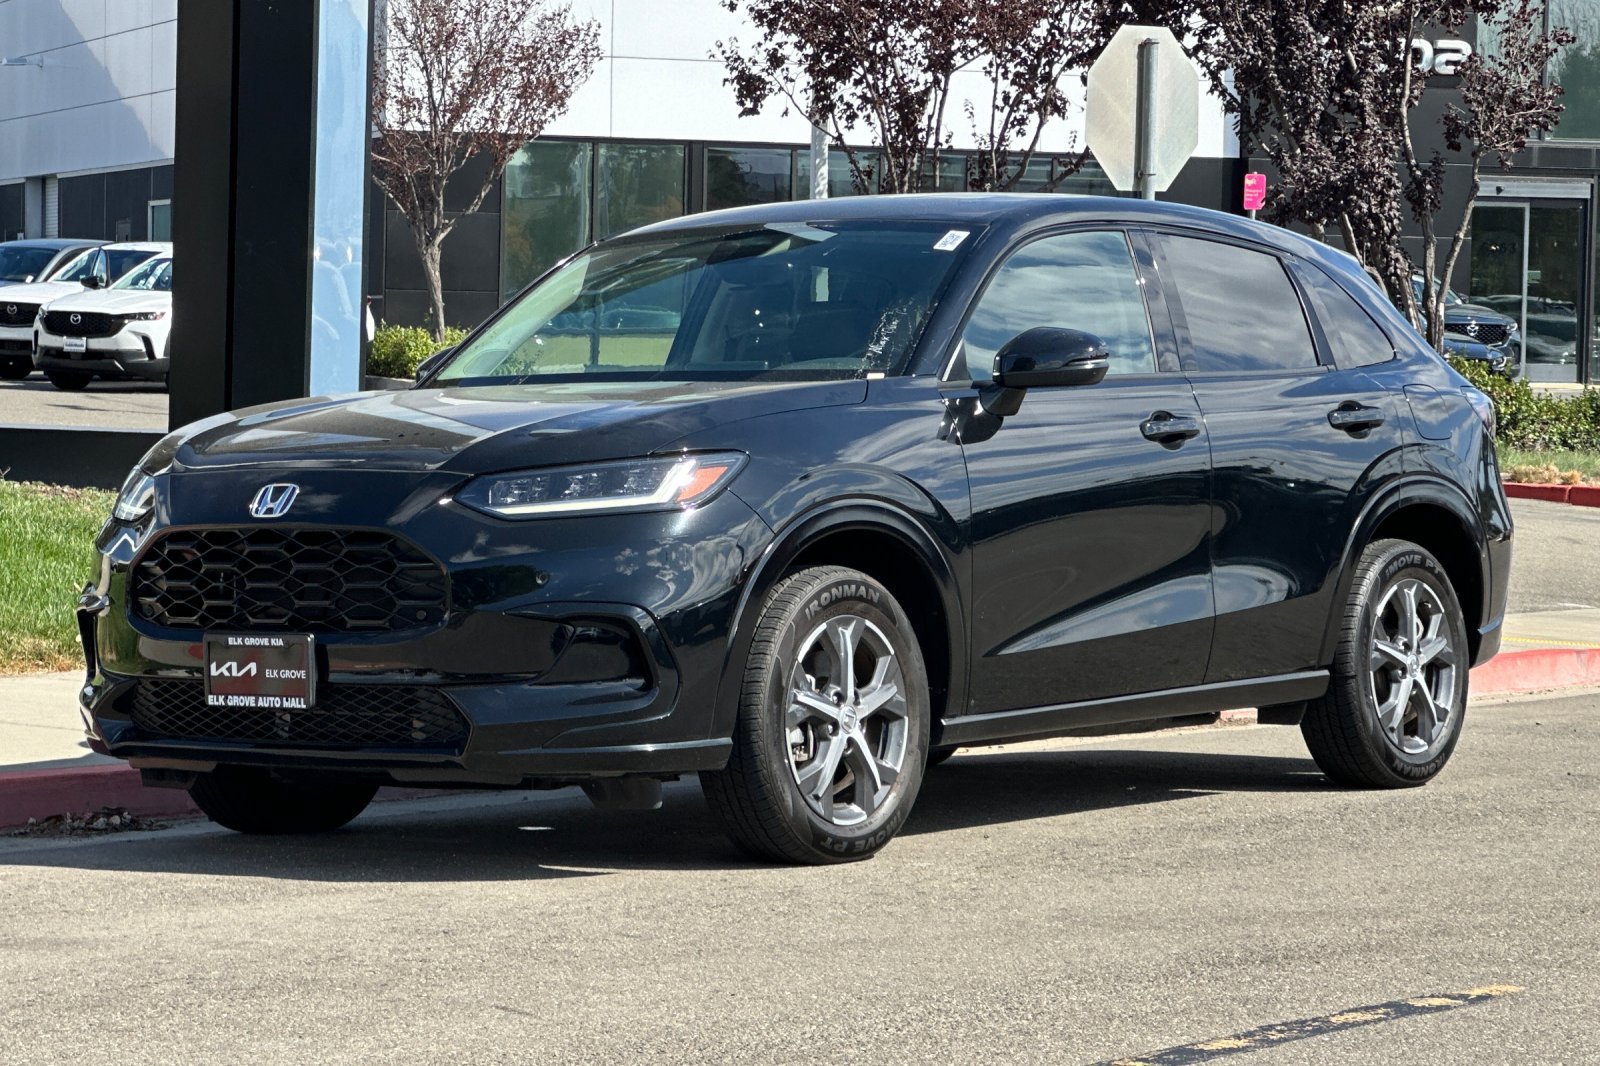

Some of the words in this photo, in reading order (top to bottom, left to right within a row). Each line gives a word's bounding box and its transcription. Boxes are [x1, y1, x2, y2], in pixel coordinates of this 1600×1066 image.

[805, 584, 880, 620] IRONMAN
[228, 637, 243, 646] ELK
[244, 637, 269, 646] GROVE
[271, 638, 284, 646] KIA
[265, 669, 279, 678] ELK
[279, 669, 307, 679] GROVE
[207, 695, 226, 706] ELK
[226, 696, 256, 707] GROVE
[257, 696, 282, 708] AUTO
[282, 697, 307, 709] MALL
